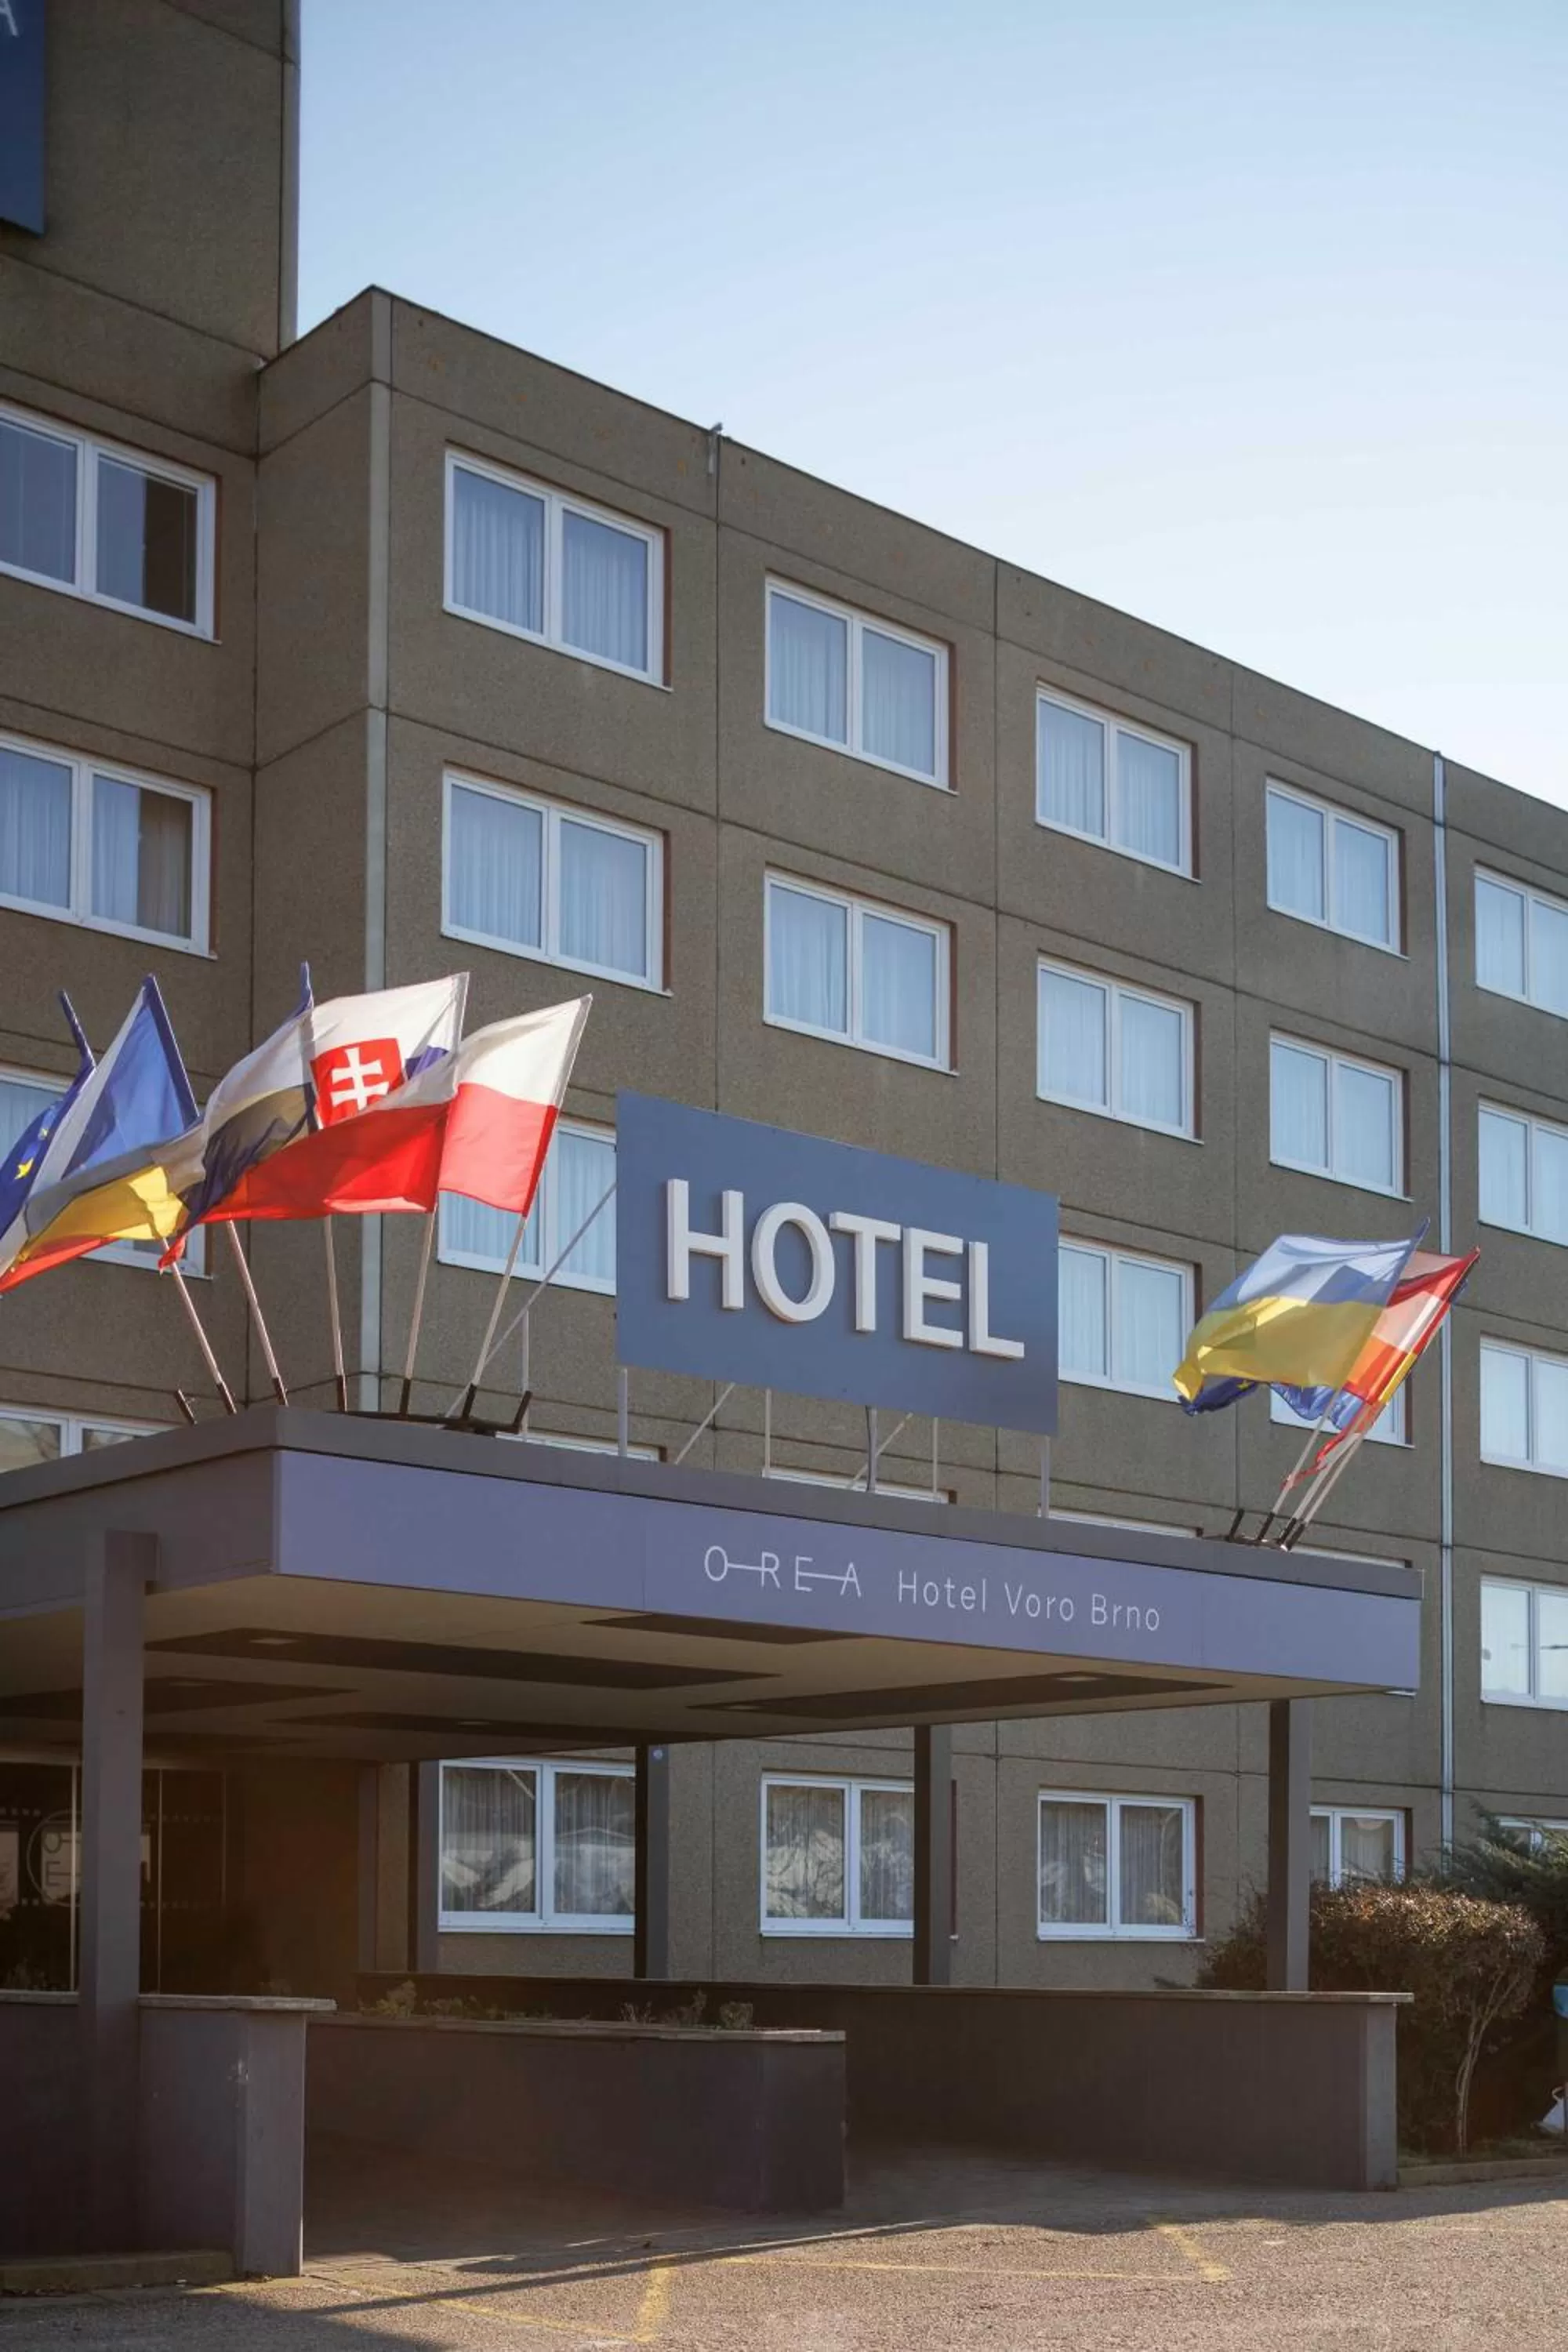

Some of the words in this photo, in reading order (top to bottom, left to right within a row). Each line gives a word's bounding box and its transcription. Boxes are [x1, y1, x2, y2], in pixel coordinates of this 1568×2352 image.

[666, 1178, 1025, 1359] HOTEL
[898, 1570, 987, 1613] Hotel
[1004, 1582, 1075, 1622] Voro
[1091, 1594, 1160, 1632] Brno
